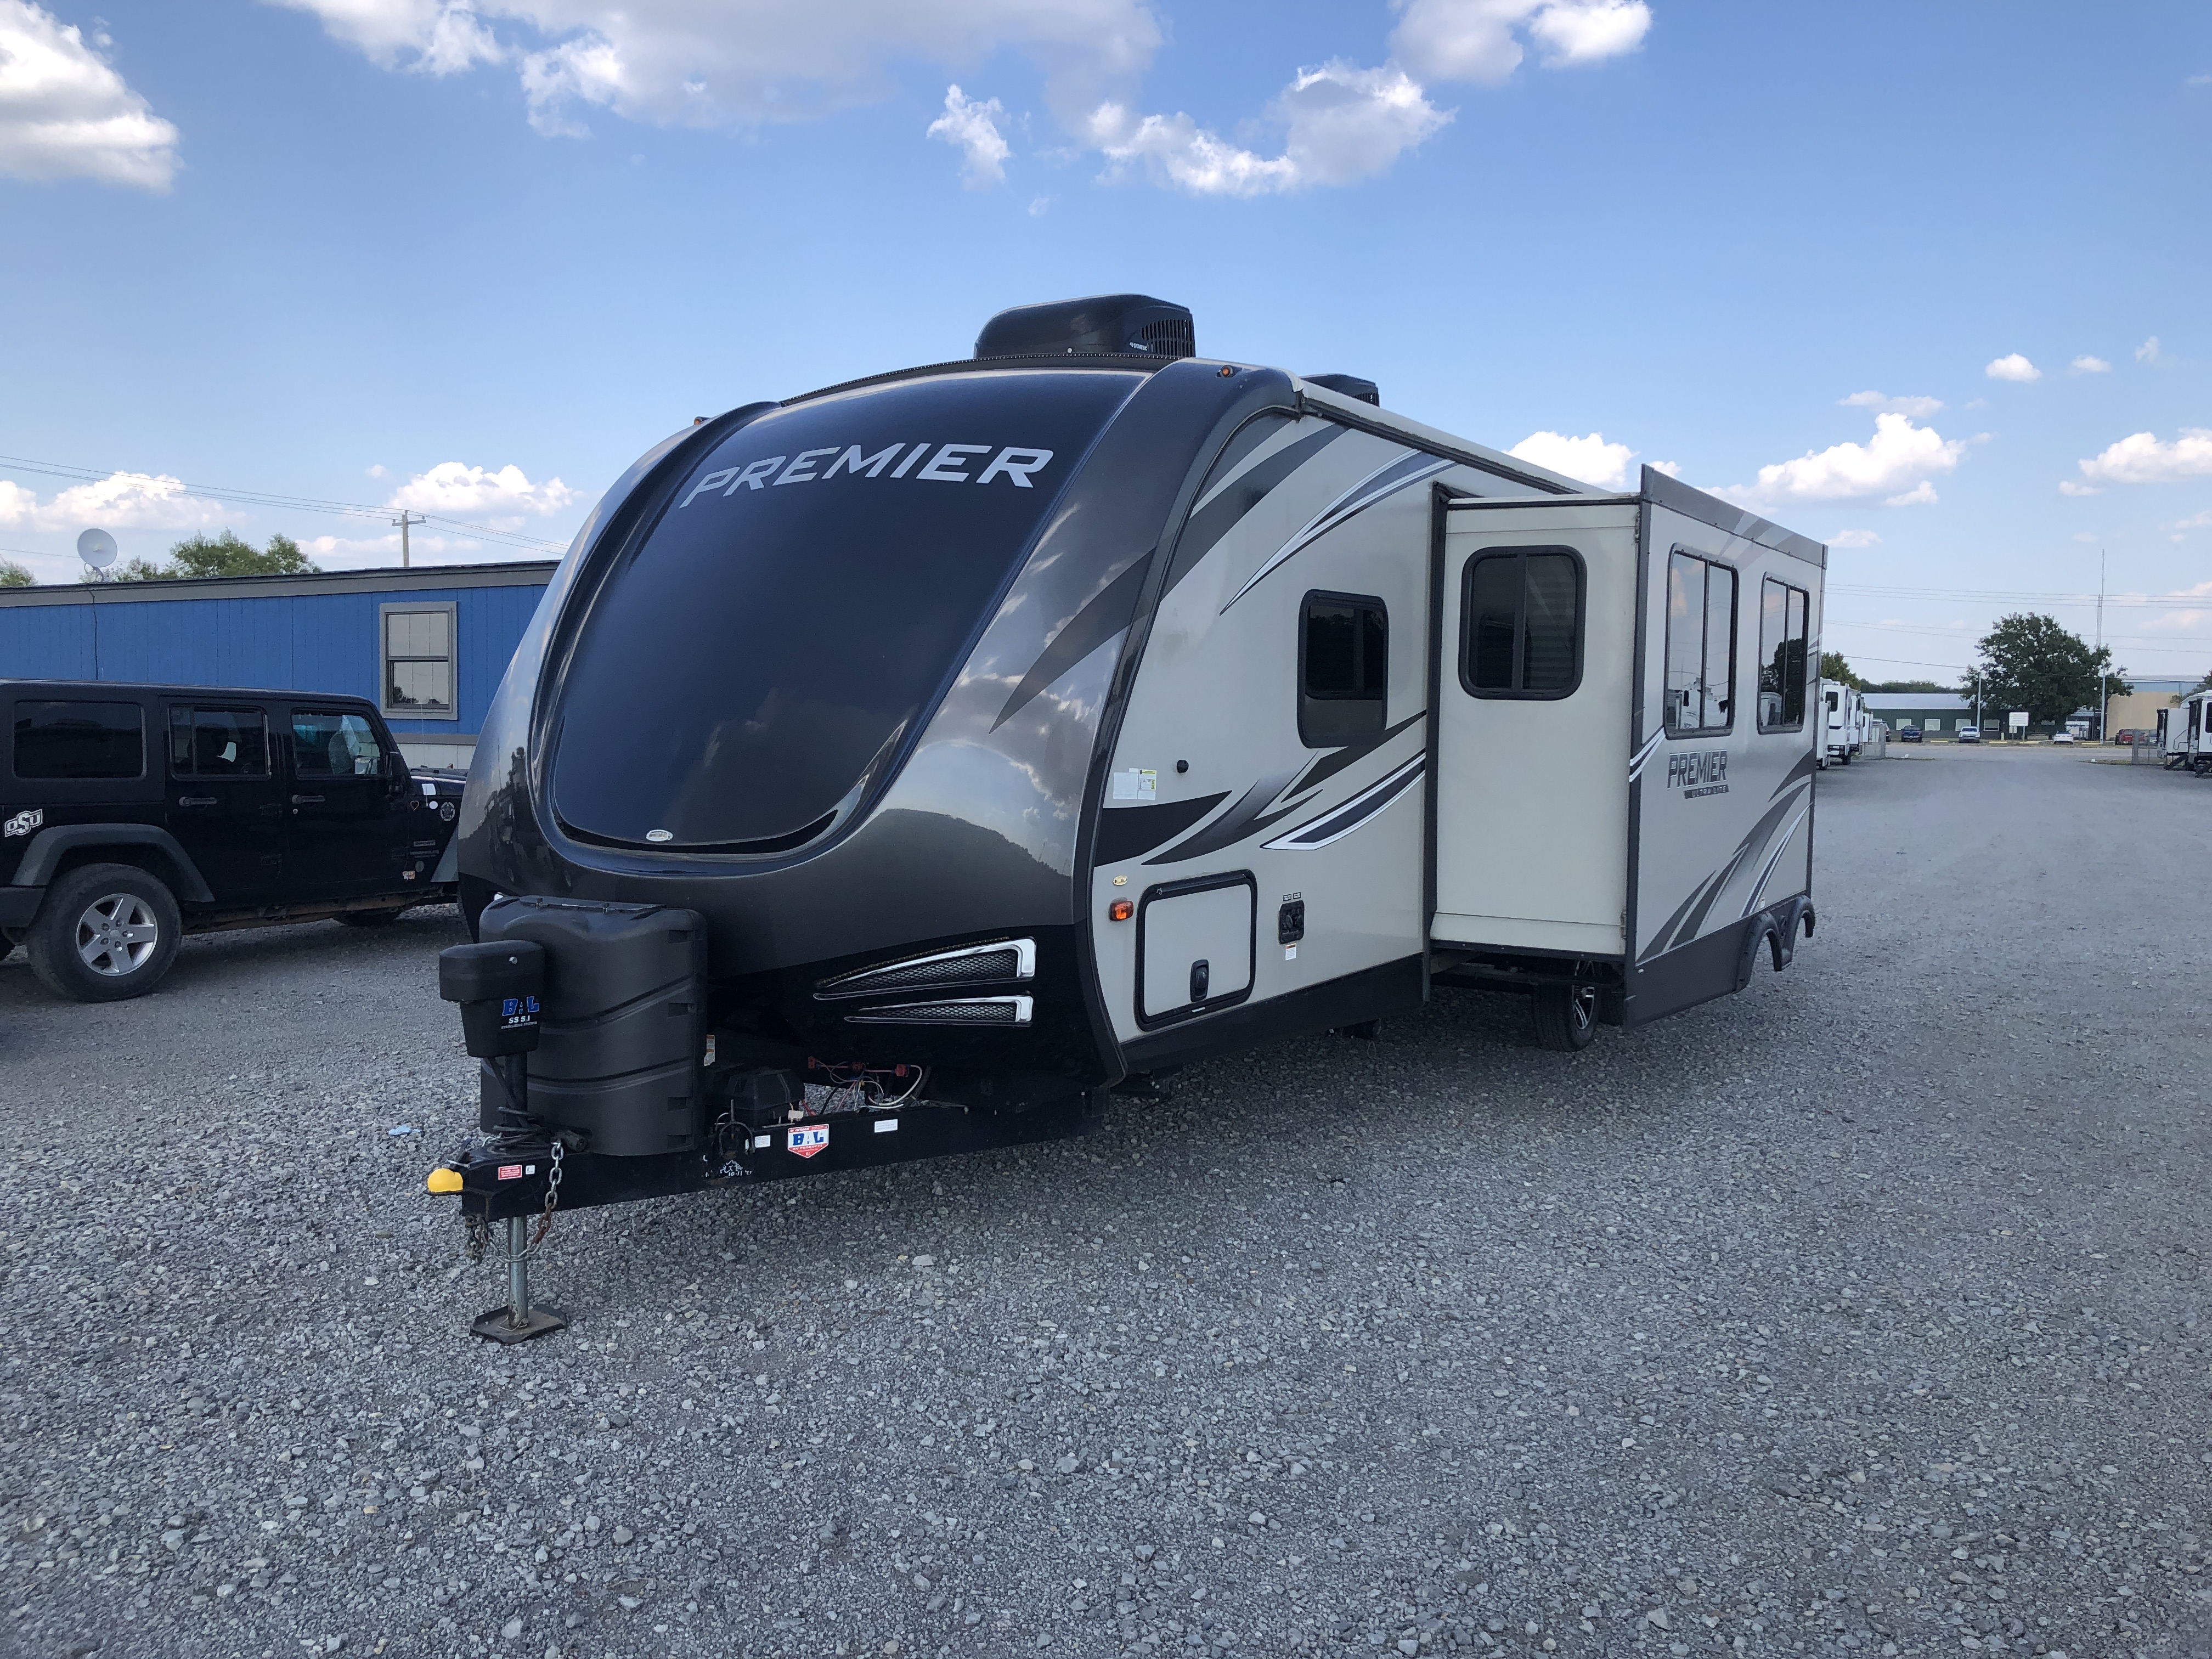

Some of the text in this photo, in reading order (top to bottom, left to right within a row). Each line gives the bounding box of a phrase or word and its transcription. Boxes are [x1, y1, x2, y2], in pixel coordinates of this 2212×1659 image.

[679, 443, 1054, 509] PREMIER
[1667, 749, 1728, 791] PREMIER
[5, 810, 42, 837] OSU
[501, 996, 540, 1016] BAL
[792, 1131, 824, 1146] BAL
